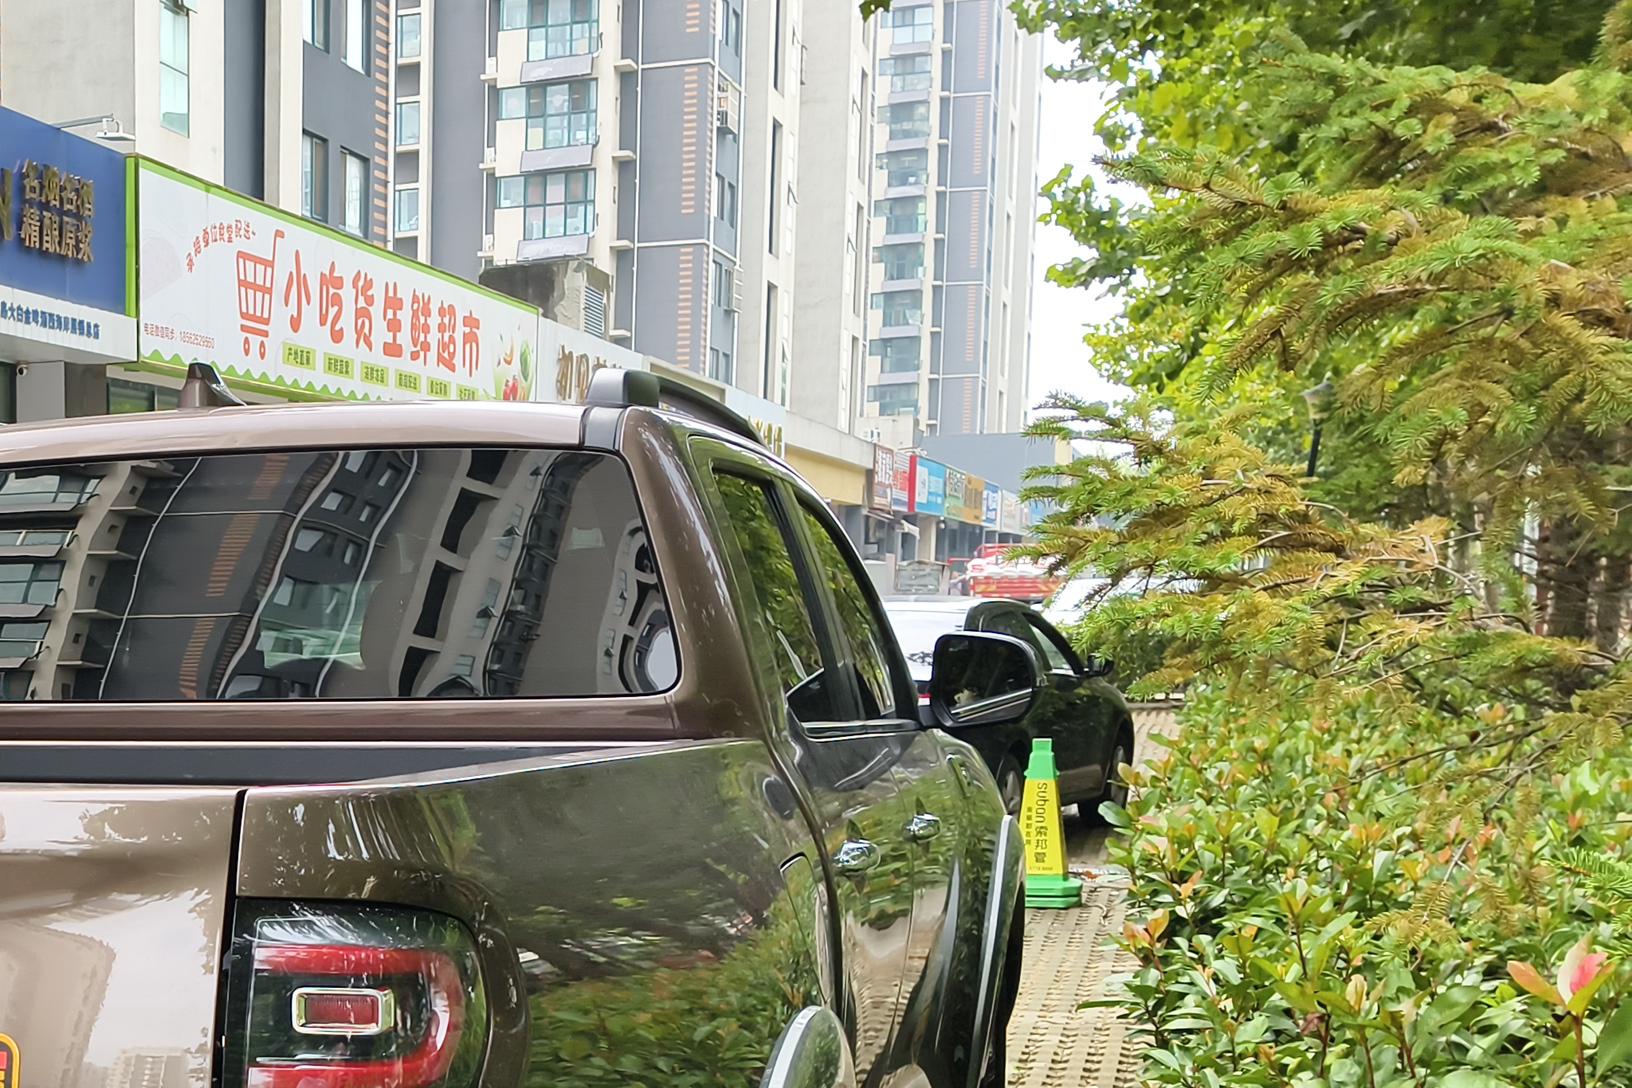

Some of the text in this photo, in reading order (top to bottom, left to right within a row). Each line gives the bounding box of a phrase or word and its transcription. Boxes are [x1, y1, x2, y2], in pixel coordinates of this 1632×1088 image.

[20, 203, 95, 264] 精酿原浆
[284, 249, 481, 378] 小吃货生鲜超市
